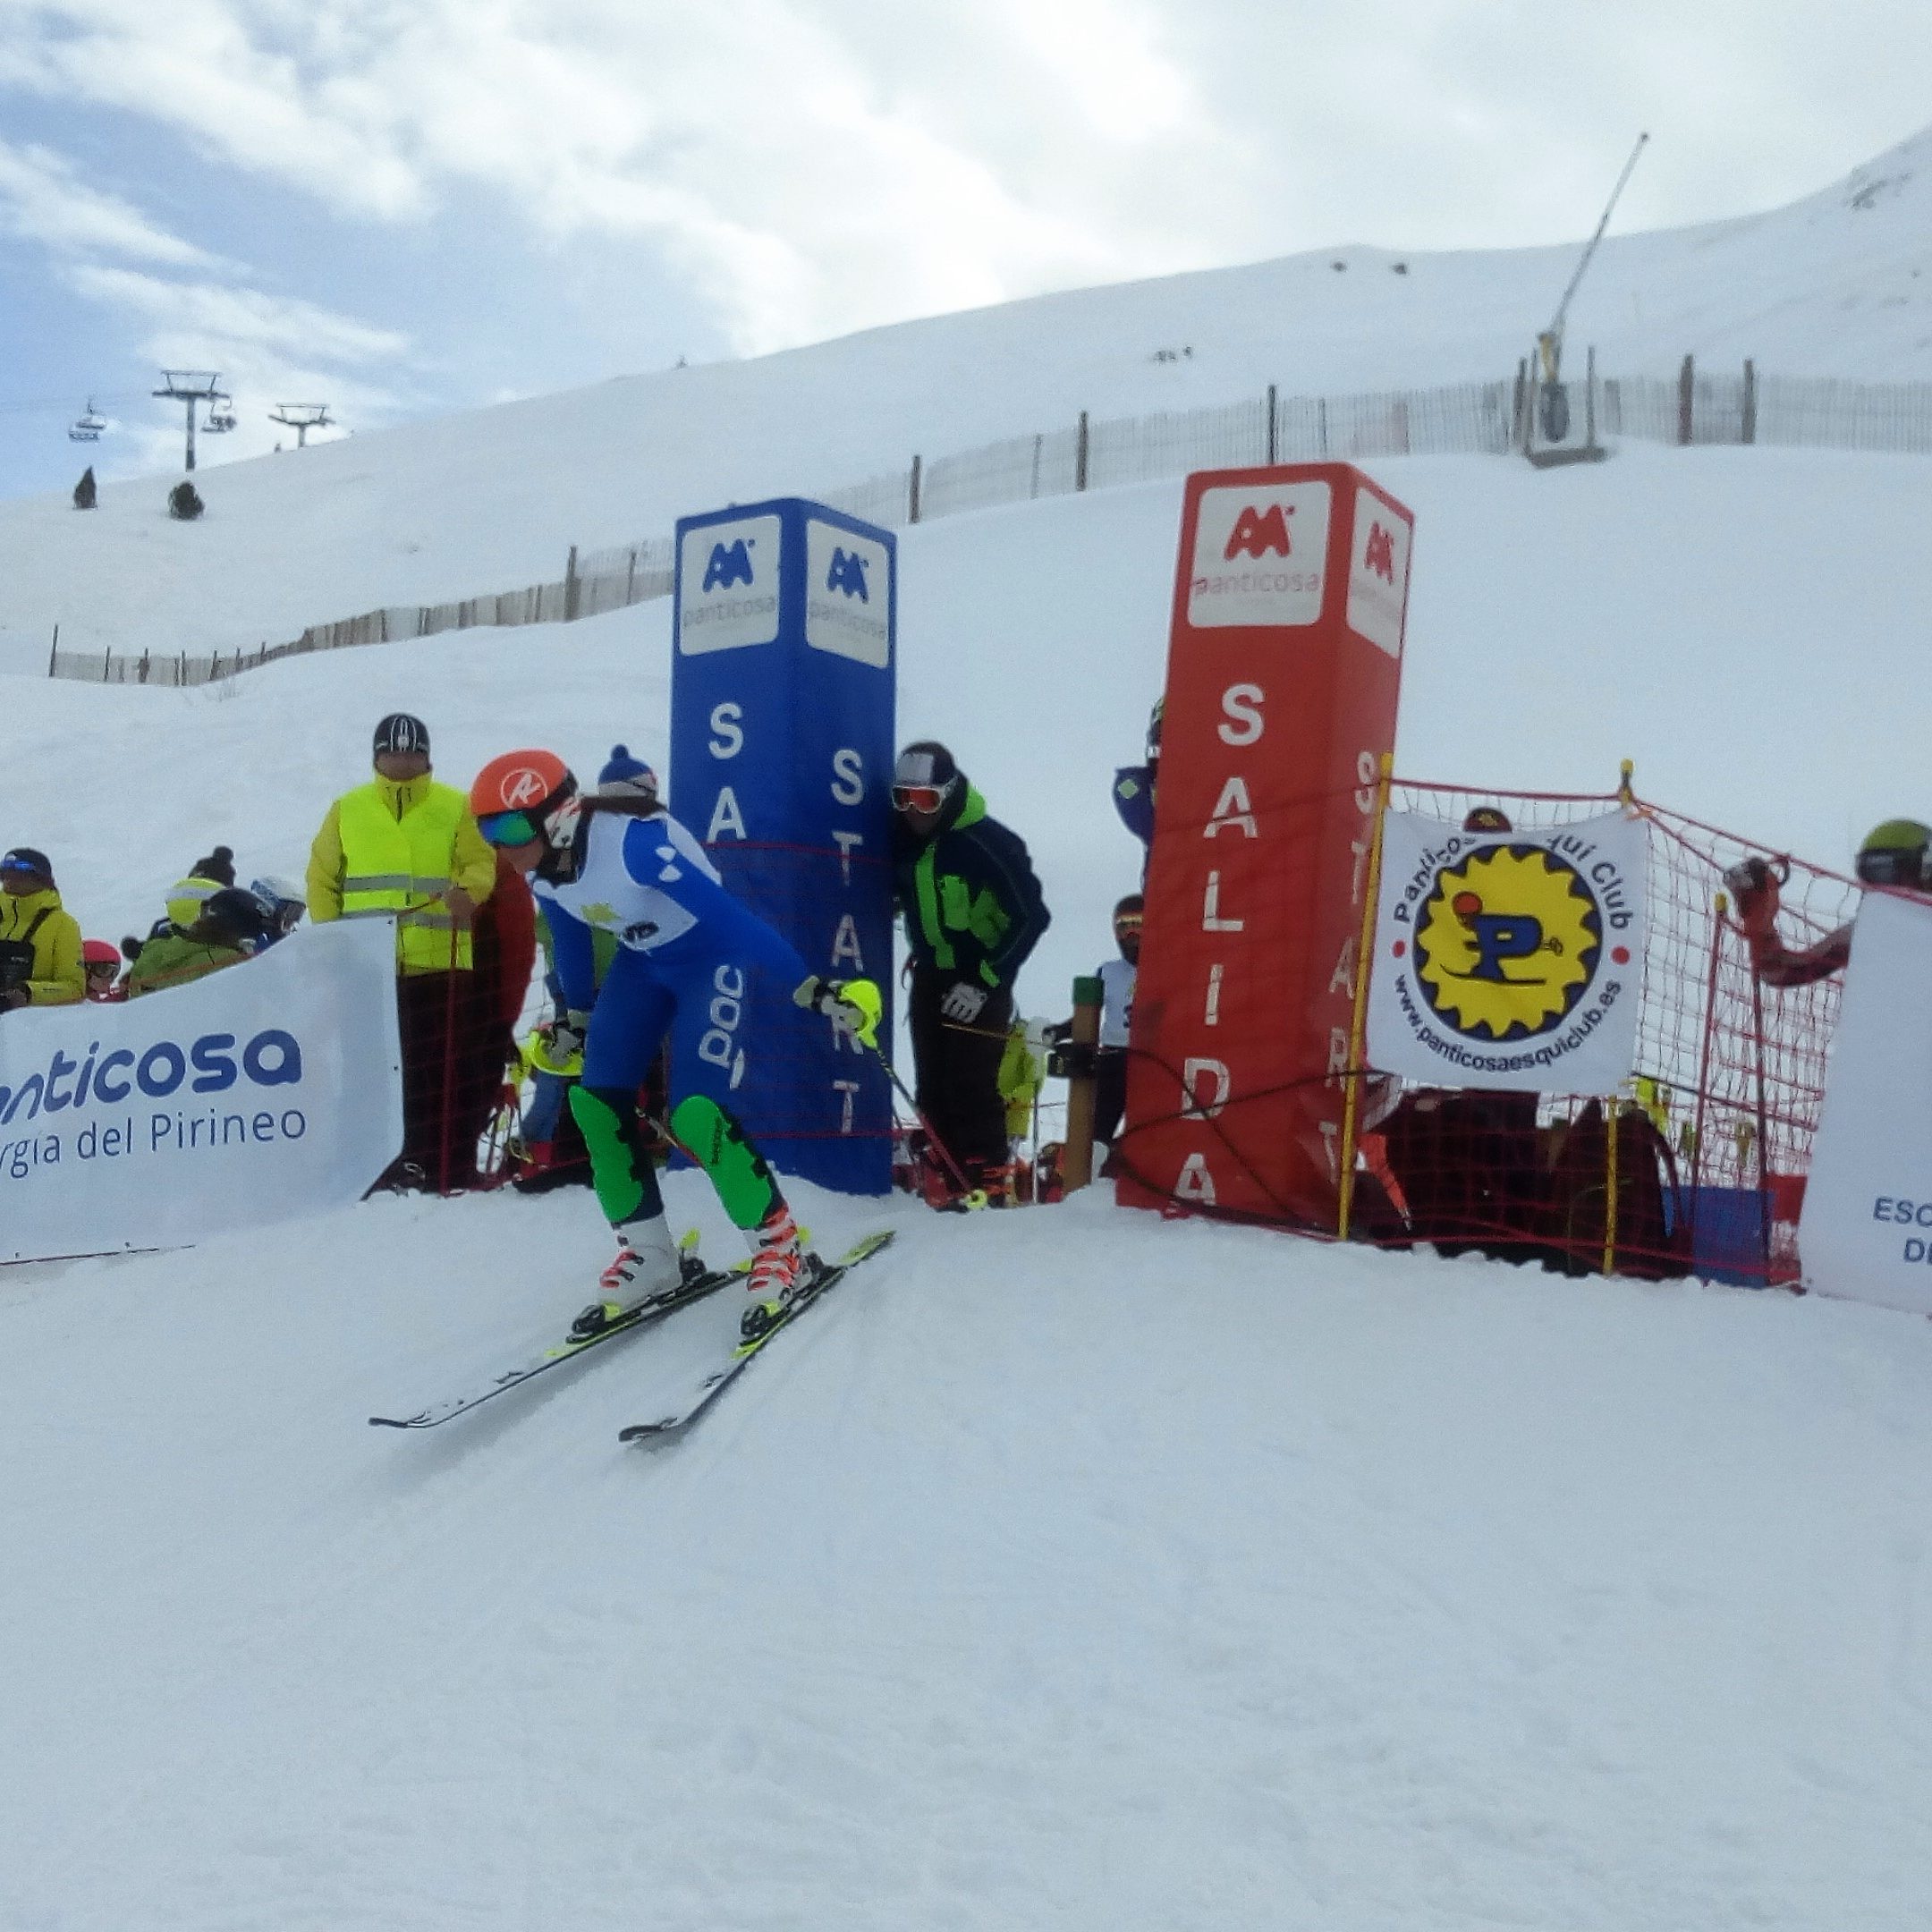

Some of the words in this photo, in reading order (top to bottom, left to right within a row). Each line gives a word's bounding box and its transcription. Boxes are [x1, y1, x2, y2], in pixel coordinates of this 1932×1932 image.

[1592, 862, 1633, 928] Club
[77, 1117, 132, 1160] del
[150, 1108, 306, 1152] Pirineo
